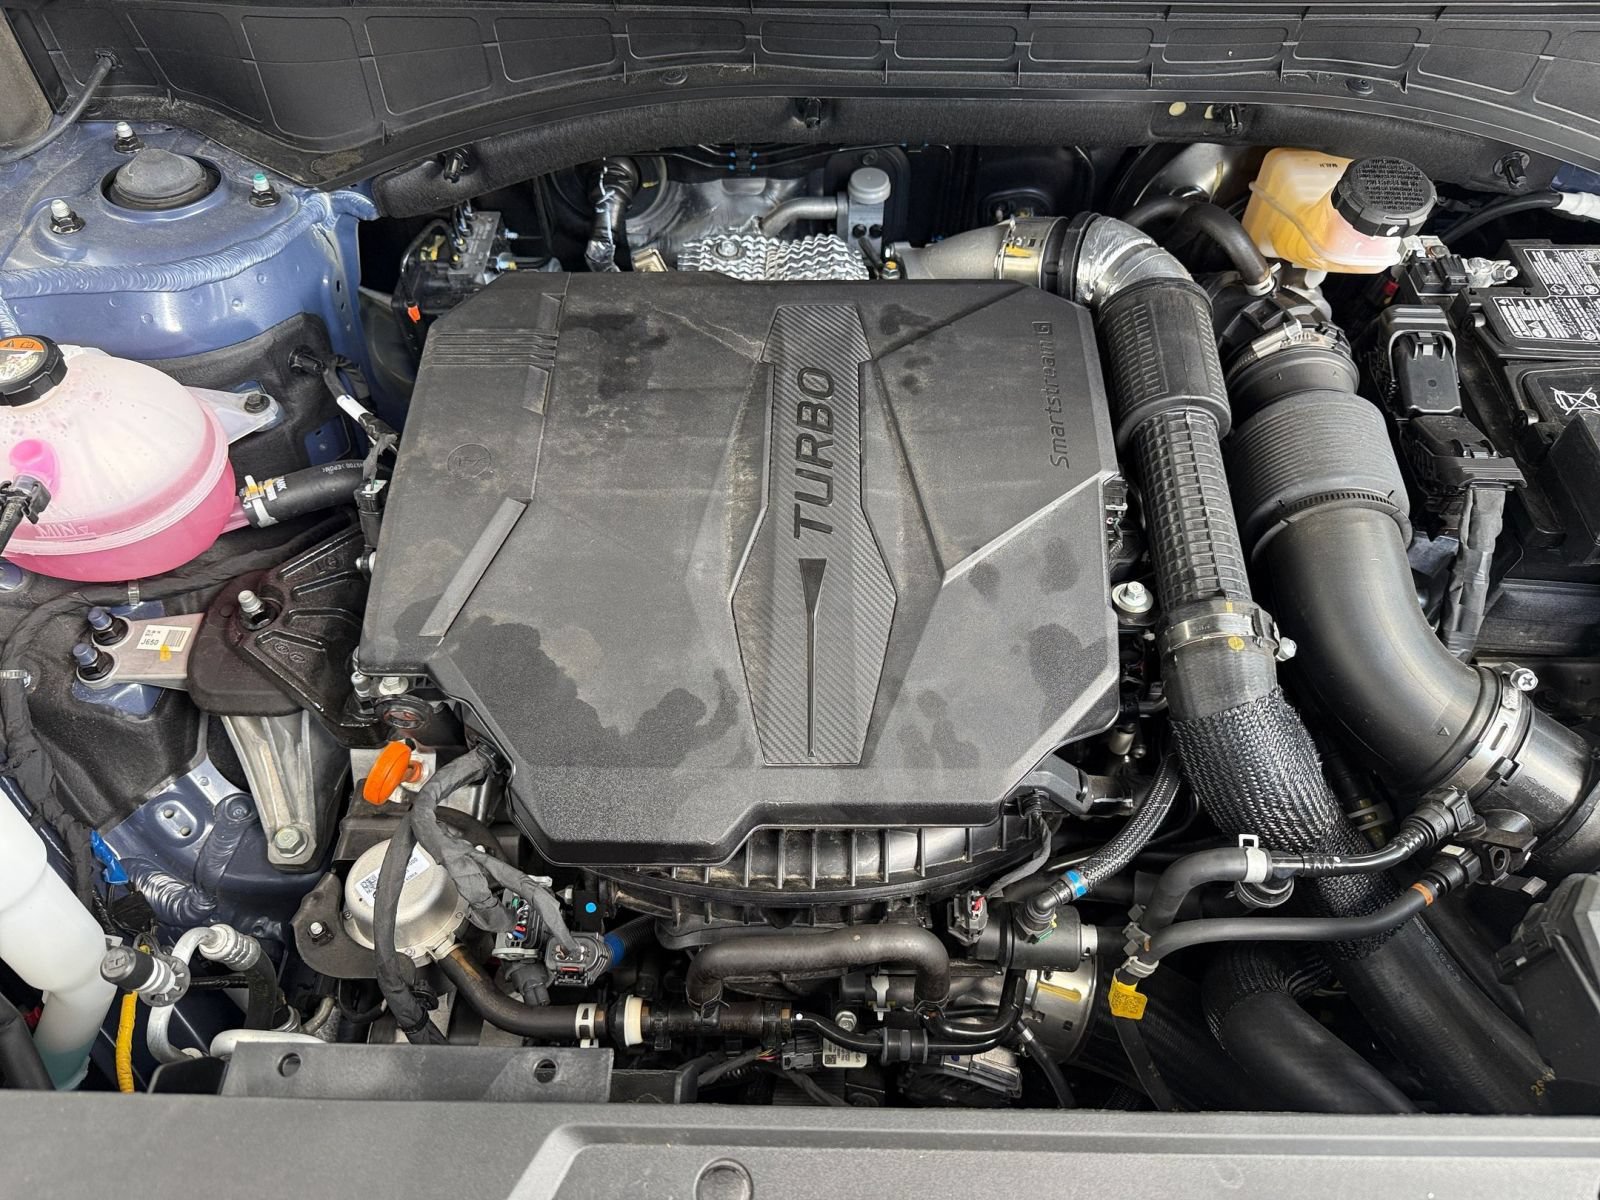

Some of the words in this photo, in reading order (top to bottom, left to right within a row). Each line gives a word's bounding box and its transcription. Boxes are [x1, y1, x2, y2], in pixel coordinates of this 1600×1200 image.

[793, 366, 835, 539] TURBO
[1040, 339, 1069, 470] Smartstream
[34, 522, 77, 537] MIN
